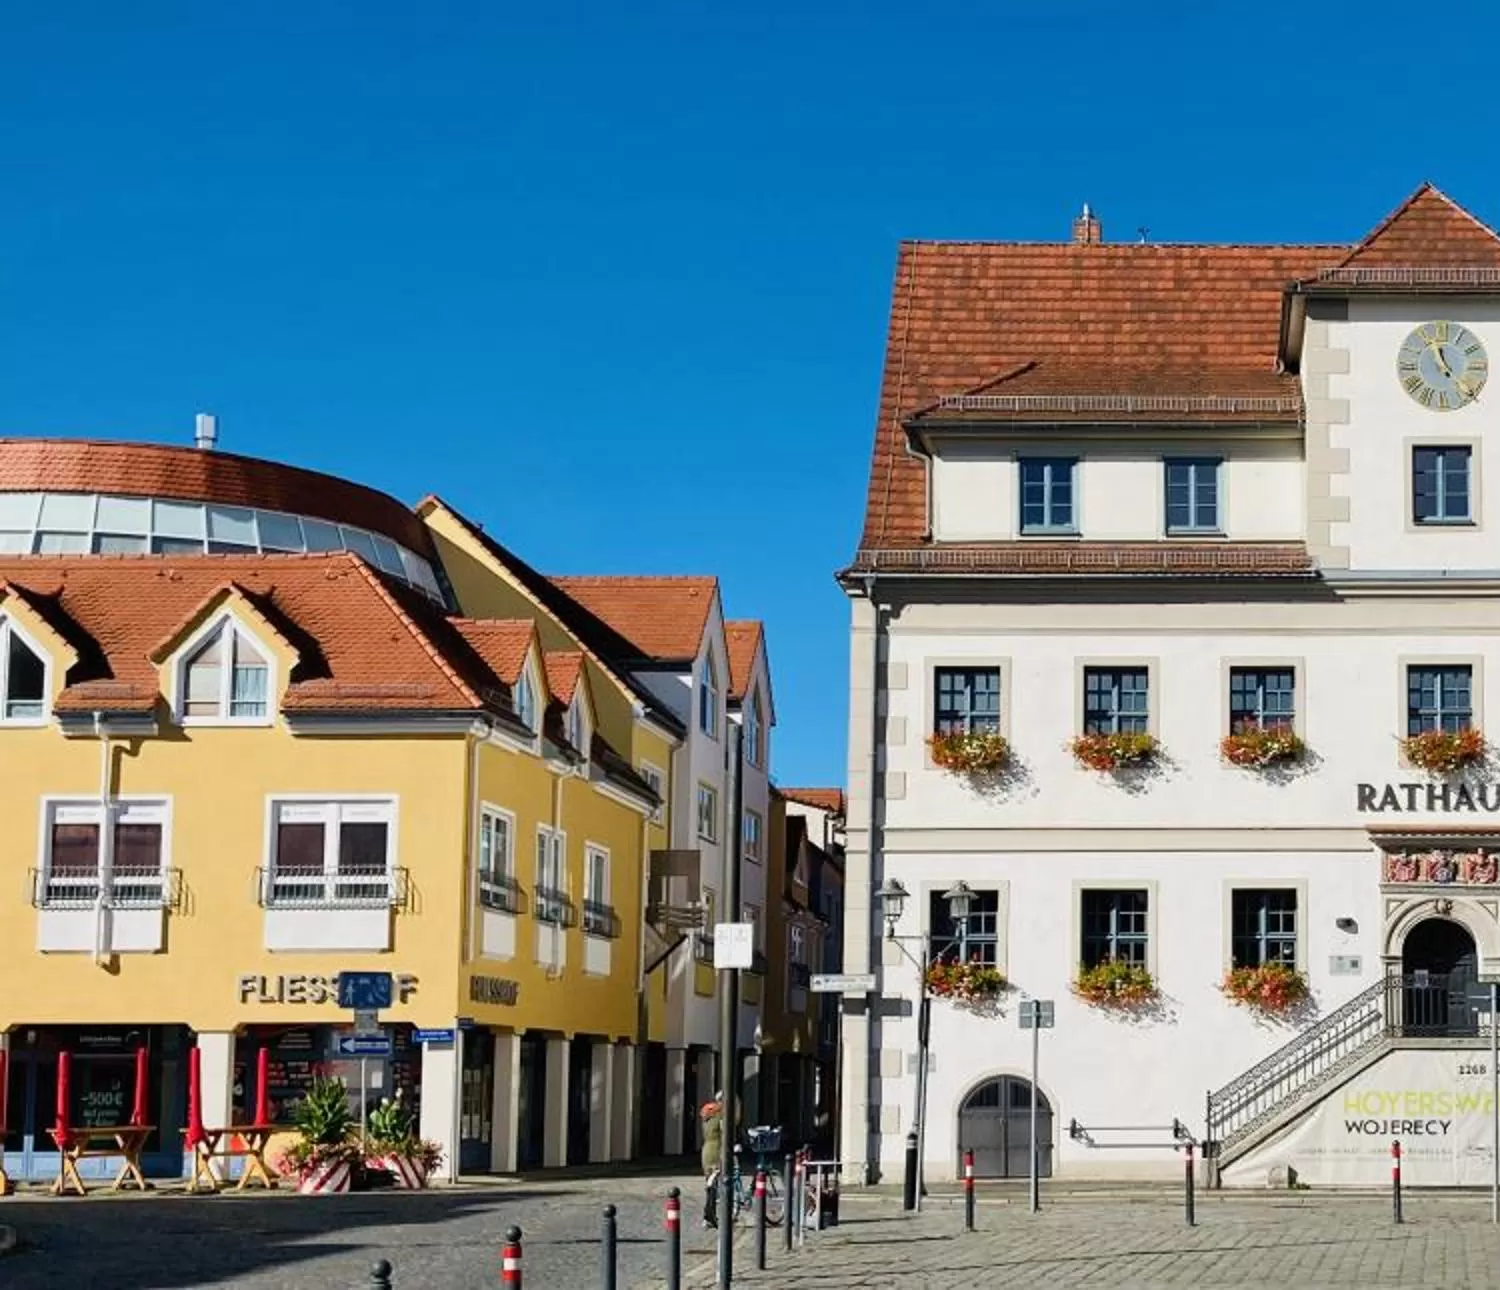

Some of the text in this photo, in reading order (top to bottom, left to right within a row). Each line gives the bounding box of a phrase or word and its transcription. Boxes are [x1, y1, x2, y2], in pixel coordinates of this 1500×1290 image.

[239, 975, 420, 1005] FLIESSF
[1458, 1064, 1487, 1075] 1268
[1345, 1119, 1452, 1135] WOJERECY
